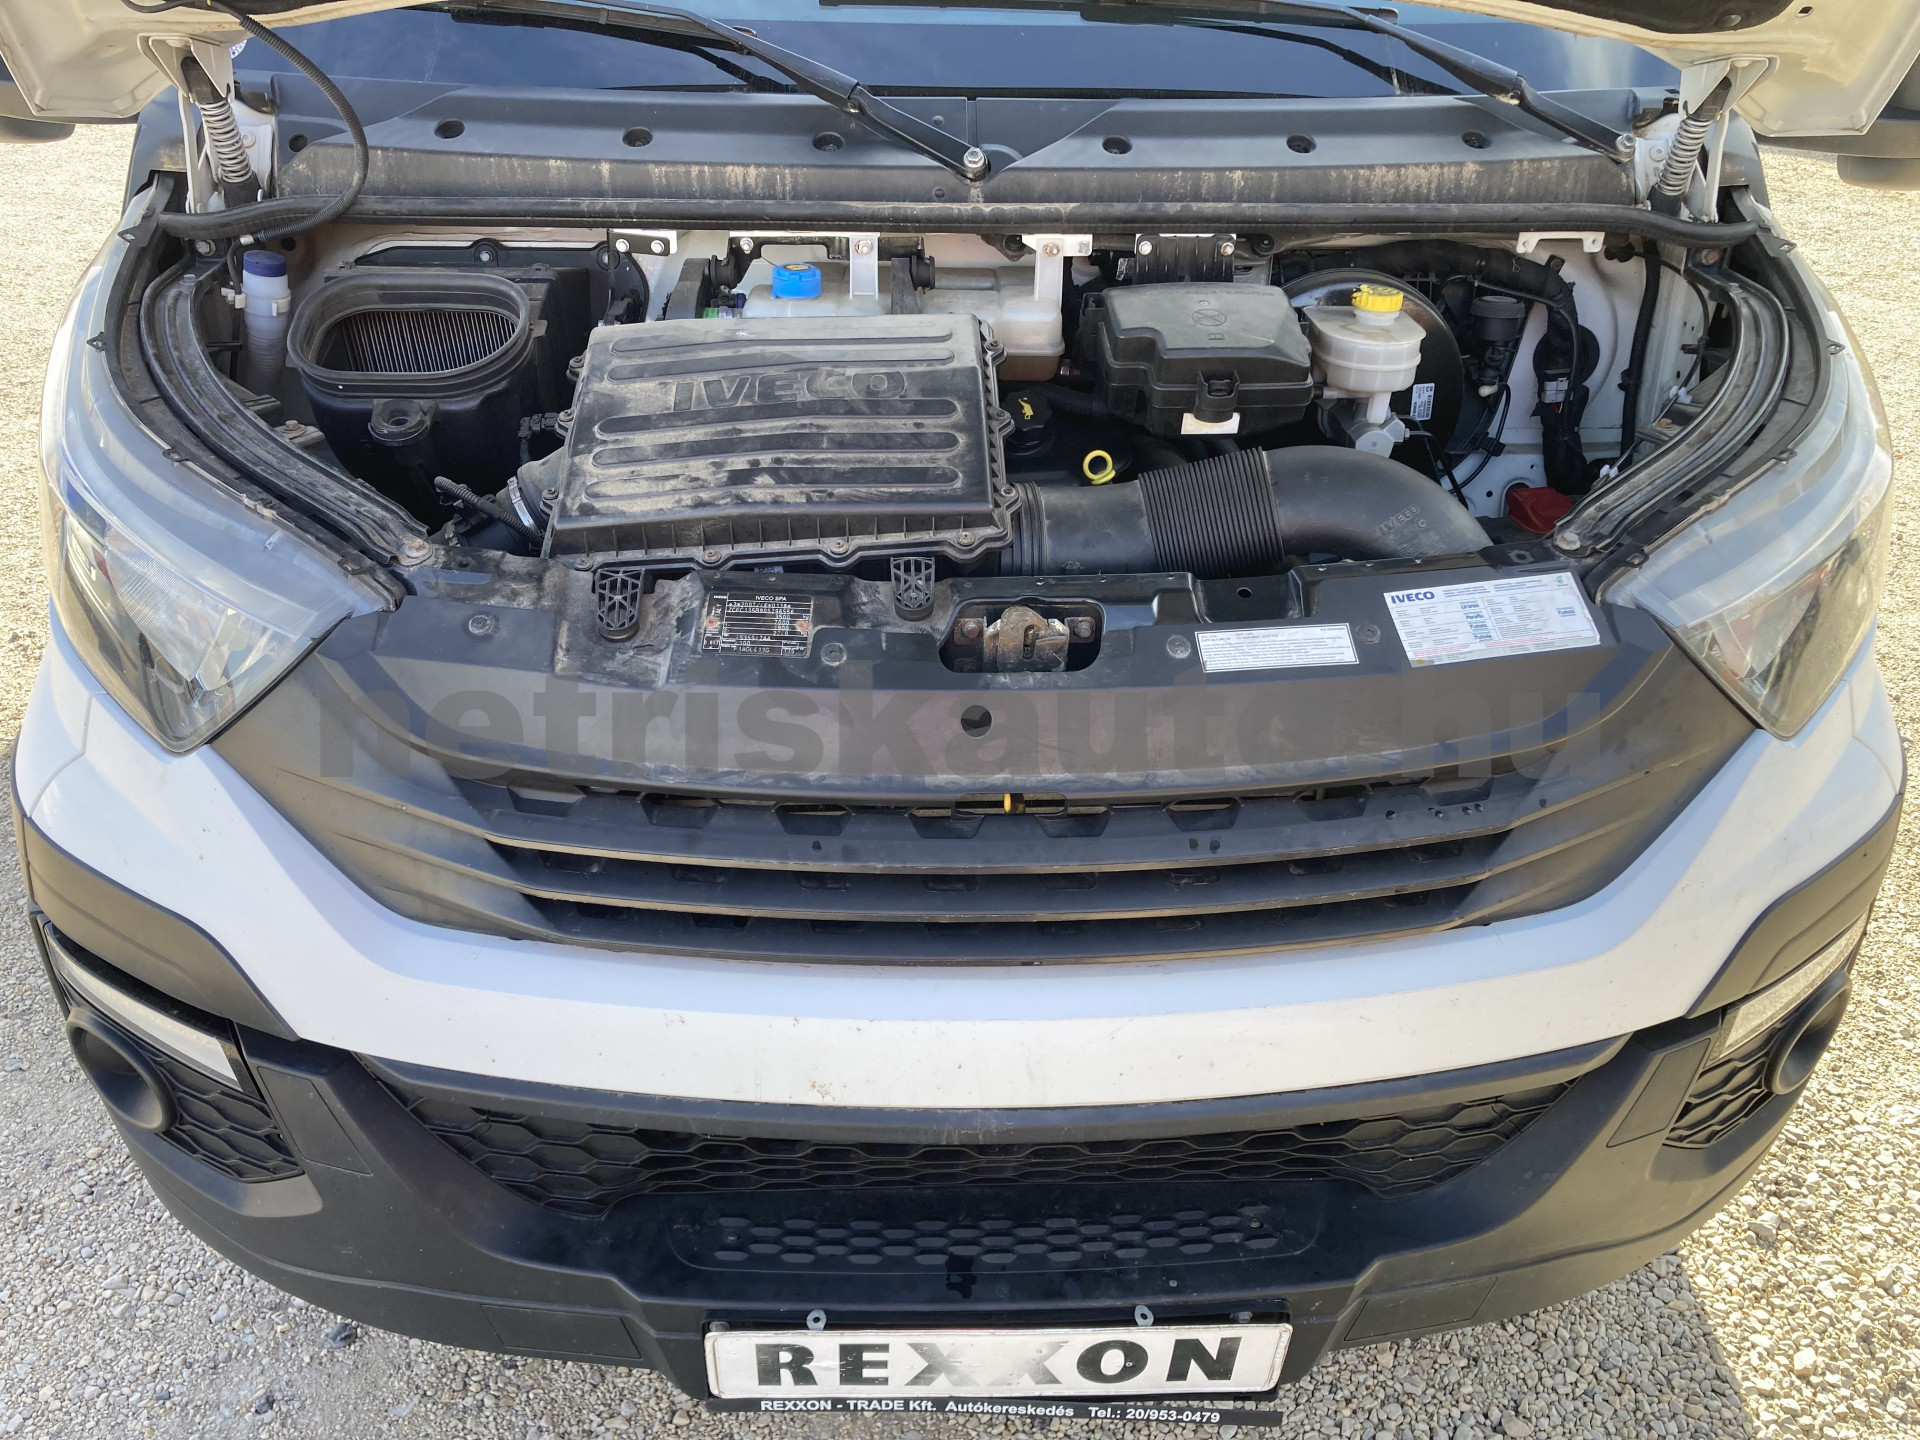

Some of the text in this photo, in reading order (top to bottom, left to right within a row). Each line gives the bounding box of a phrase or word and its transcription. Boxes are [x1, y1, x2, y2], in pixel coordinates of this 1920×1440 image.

[673, 370, 908, 412] IVECO
[1390, 591, 1435, 604] IVECO
[754, 1335, 1243, 1387] REXXON
[760, 1400, 832, 1411] REXXON
[847, 1400, 905, 1411] TRADE
[909, 1400, 937, 1411] Kft.
[945, 1401, 1075, 1417] Autókereskedés
[1088, 1406, 1121, 1418] Tel.:
[1126, 1408, 1221, 1423] 20/953-0479
